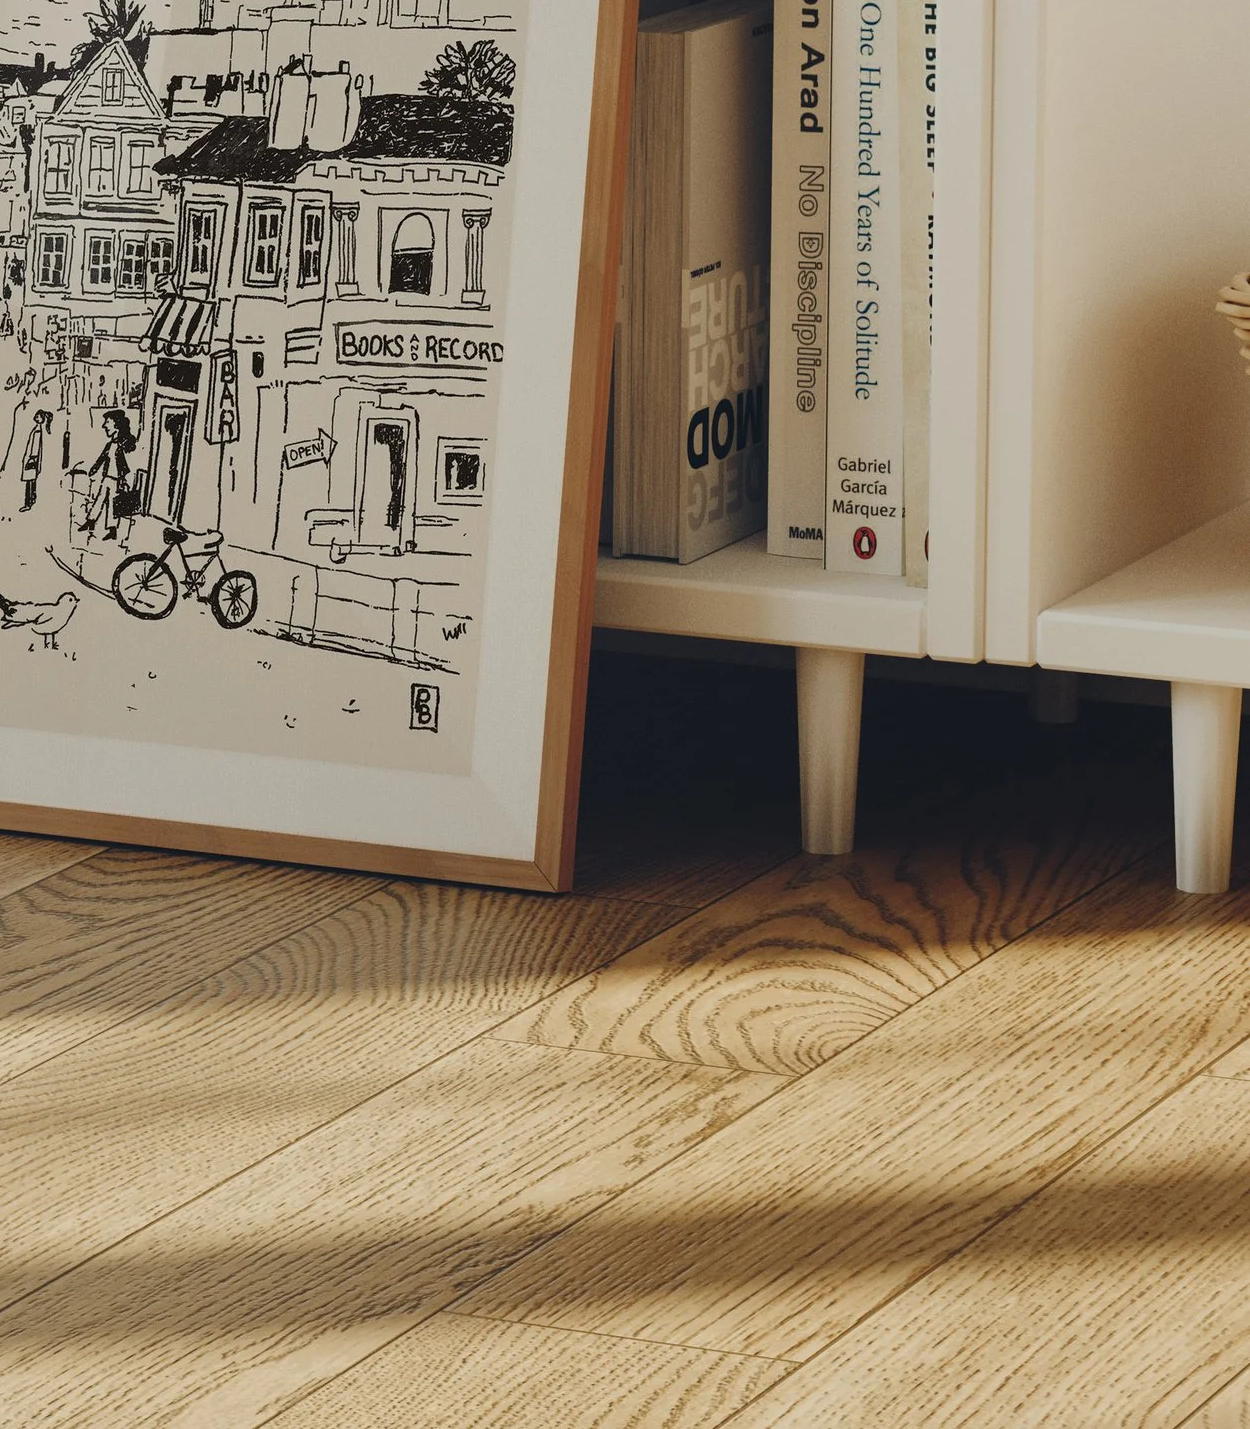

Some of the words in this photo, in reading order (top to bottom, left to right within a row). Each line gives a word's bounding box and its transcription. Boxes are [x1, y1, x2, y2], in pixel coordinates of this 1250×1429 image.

[859, 2, 883, 57] One
[800, 42, 826, 133] Arad
[858, 66, 882, 177] Hundred
[798, 165, 824, 217] No
[857, 185, 881, 253] Years
[856, 261, 880, 291] of
[342, 332, 405, 359] BOOKS
[409, 333, 420, 362] AND
[425, 334, 504, 363] RECORD
[792, 232, 824, 413] Discipline
[855, 300, 880, 401] Solitude
[218, 360, 236, 438] BAR
[687, 384, 765, 471] MOD
[837, 456, 892, 474] Gabriel
[840, 478, 888, 495] García
[789, 526, 824, 541] MoMA
[832, 499, 897, 519] Márquez
